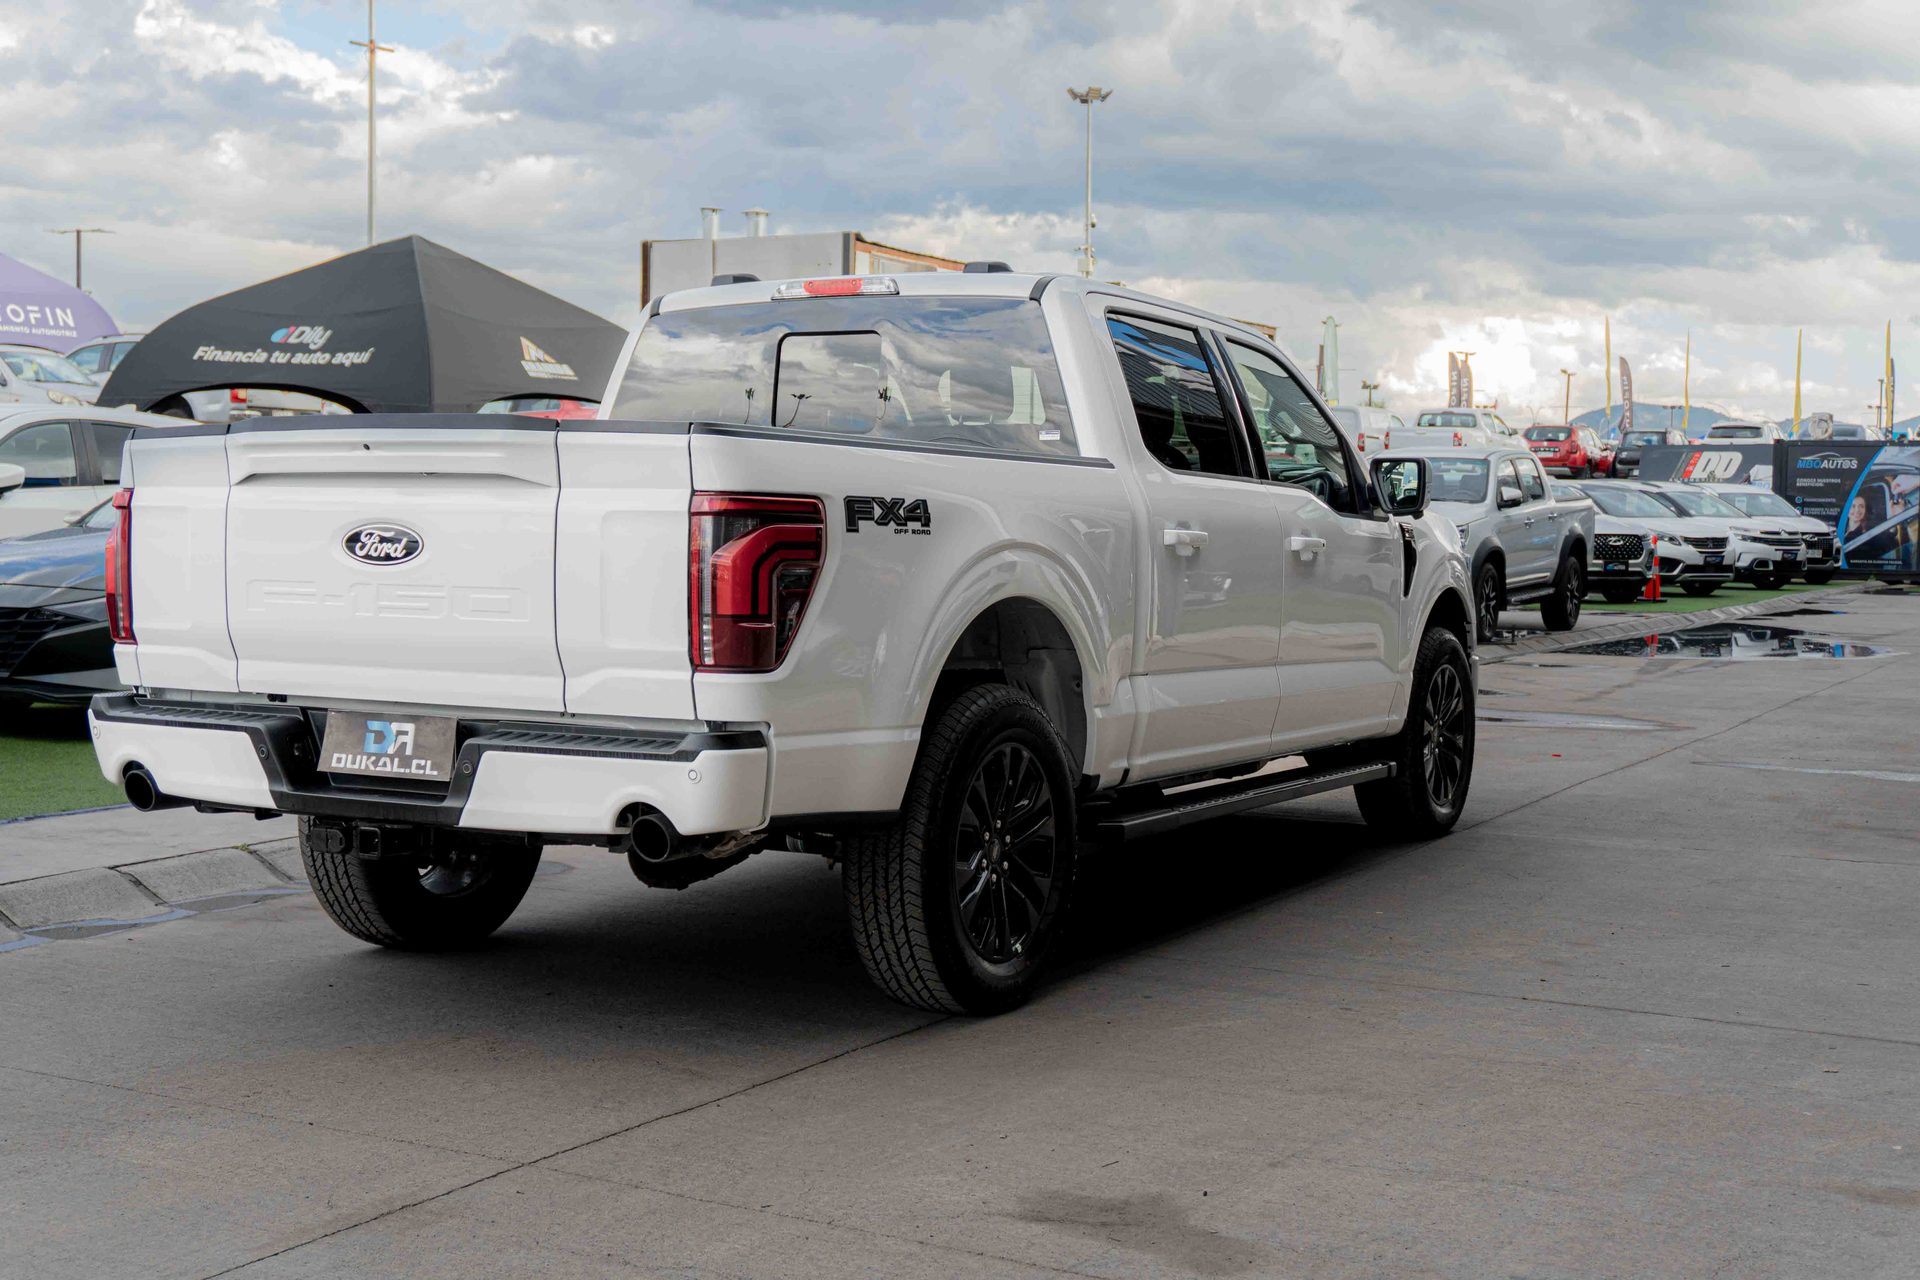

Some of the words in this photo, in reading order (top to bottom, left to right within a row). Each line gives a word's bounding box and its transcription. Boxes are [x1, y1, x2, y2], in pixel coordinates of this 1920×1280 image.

[0, 303, 75, 328] OFIN
[192, 345, 268, 363] Financia
[269, 350, 292, 364] tu
[291, 351, 332, 365] auto
[331, 347, 375, 367] aquí
[843, 495, 931, 533] FX4
[355, 529, 408, 558] Ford
[246, 579, 530, 622] F-150
[331, 752, 438, 775] DUKAL.CL
